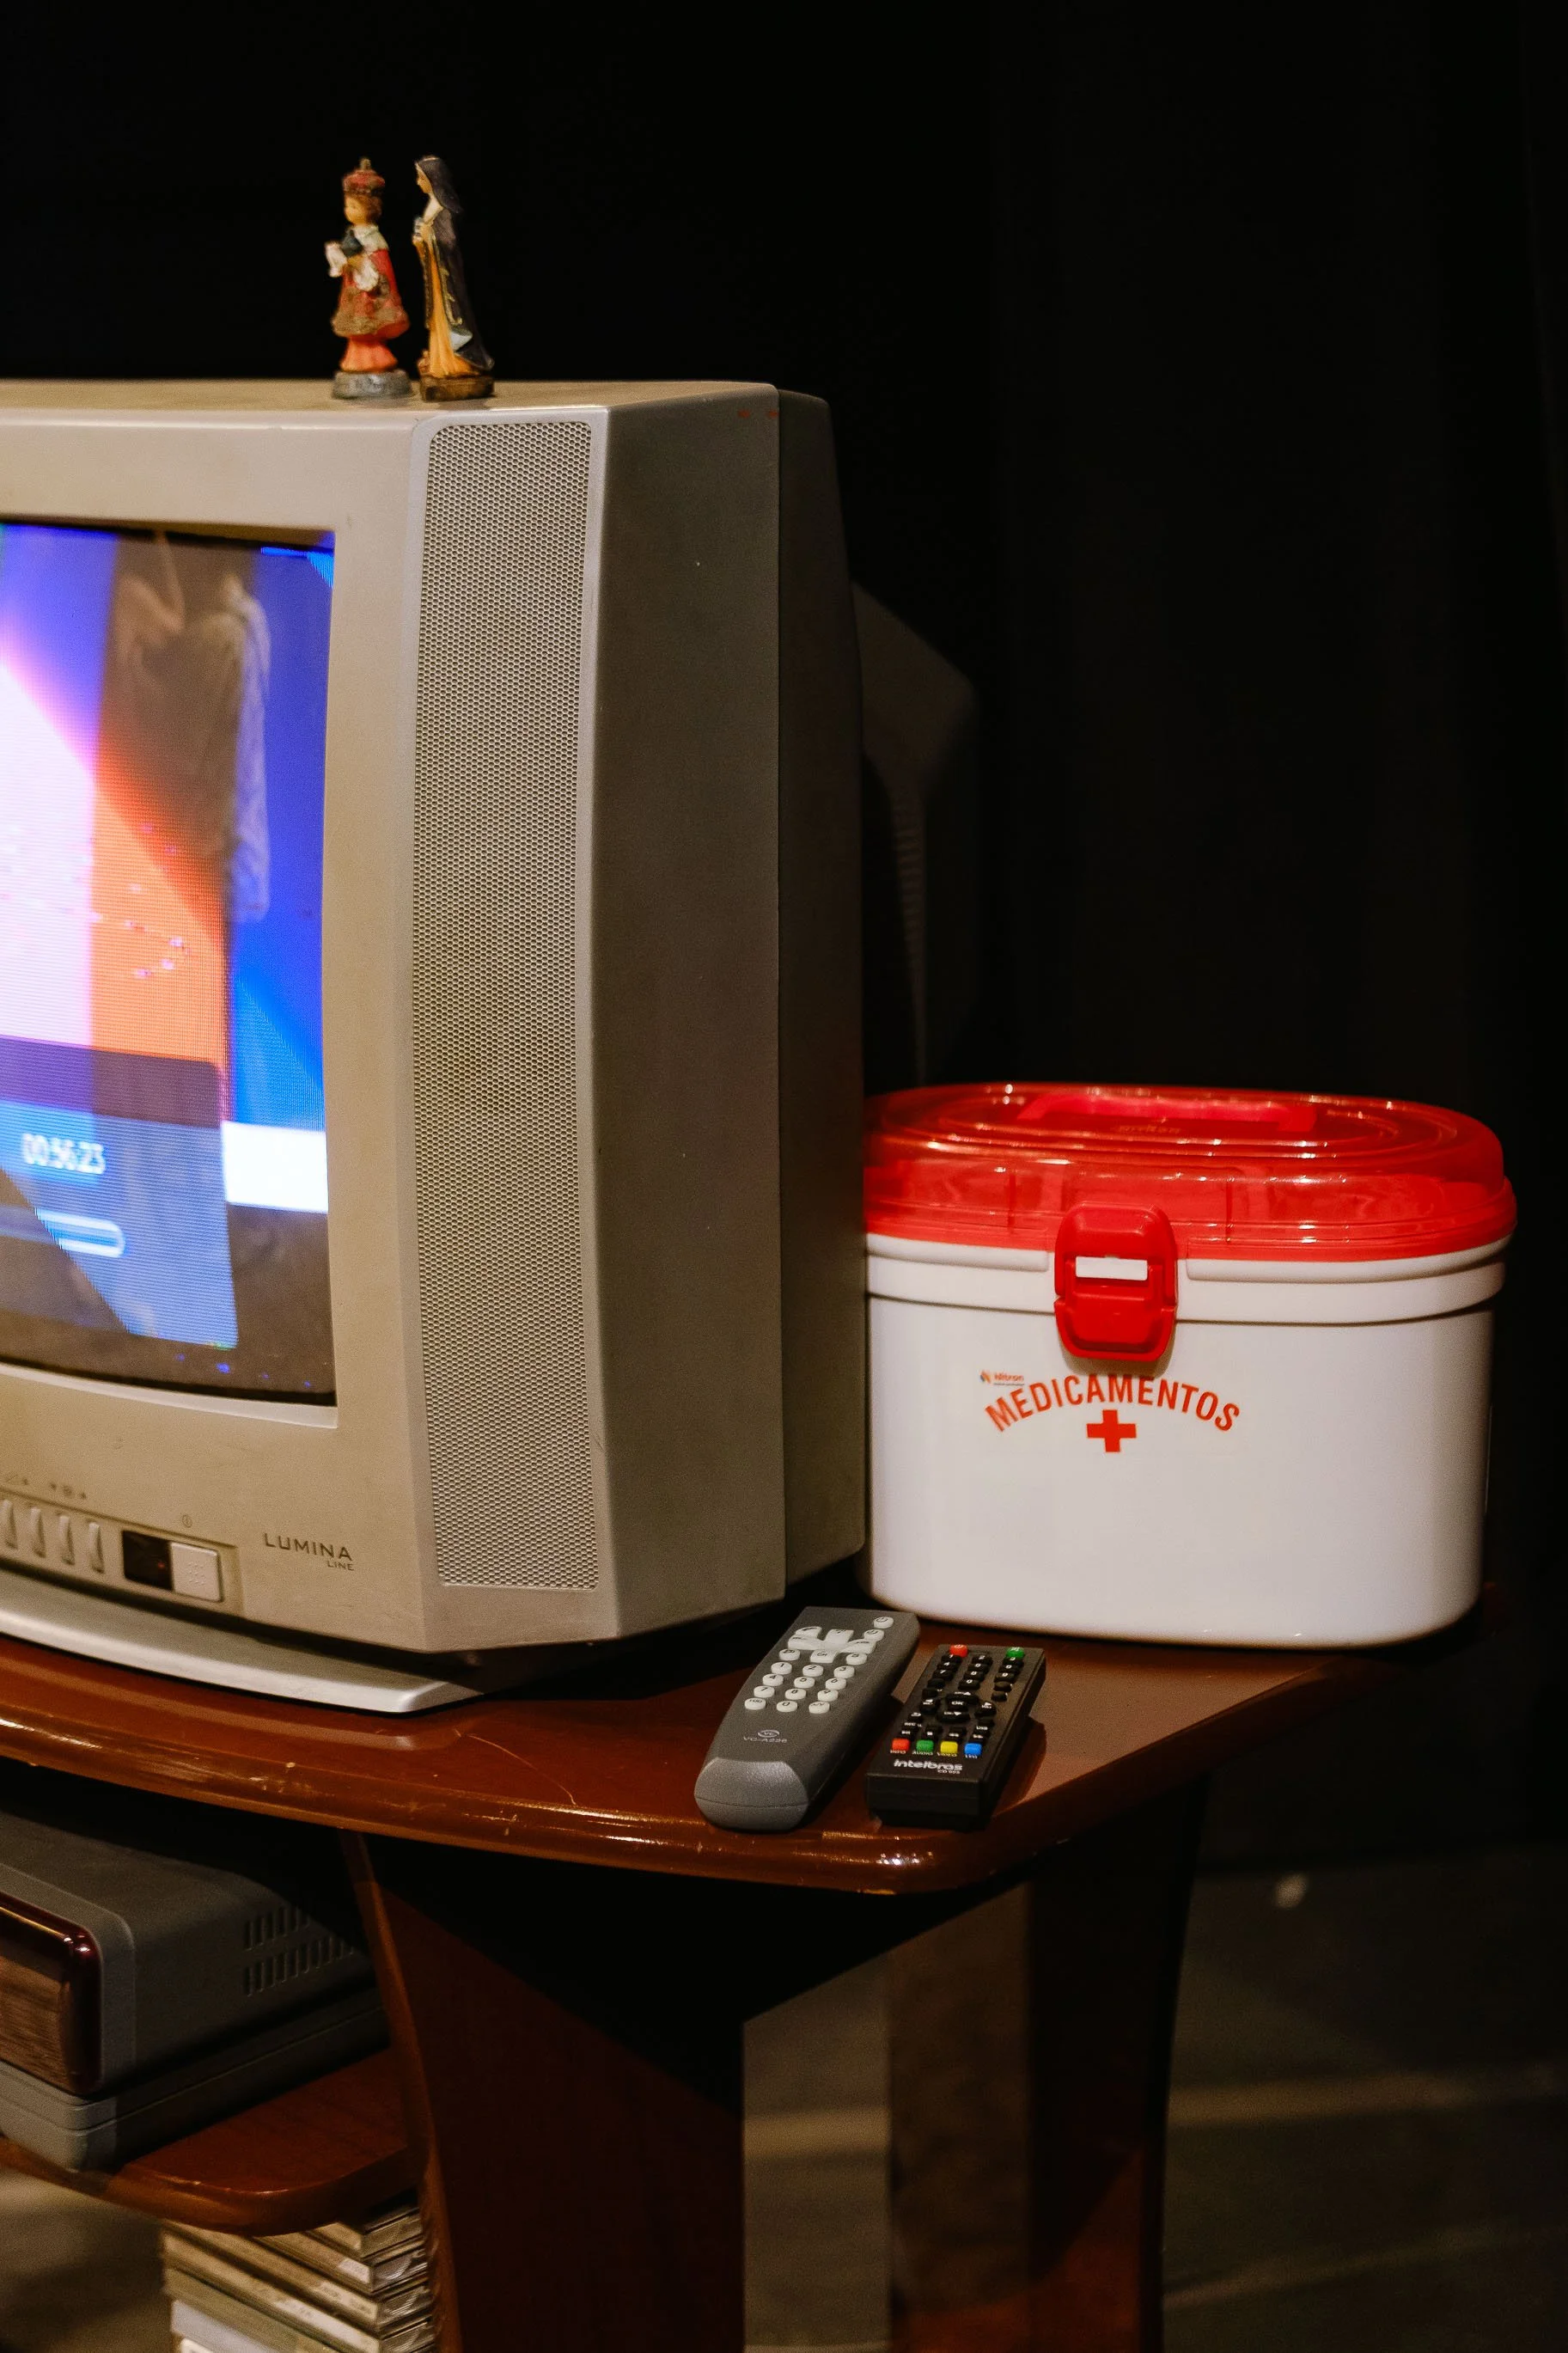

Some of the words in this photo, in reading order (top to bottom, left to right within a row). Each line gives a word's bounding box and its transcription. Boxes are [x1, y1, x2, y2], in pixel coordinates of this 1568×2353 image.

[985, 1373, 1240, 1432] MEDICAMENTOS
[264, 1532, 353, 1562] LUMINA
[326, 1560, 354, 1571] LINE
[894, 1758, 963, 1771] intelbras
